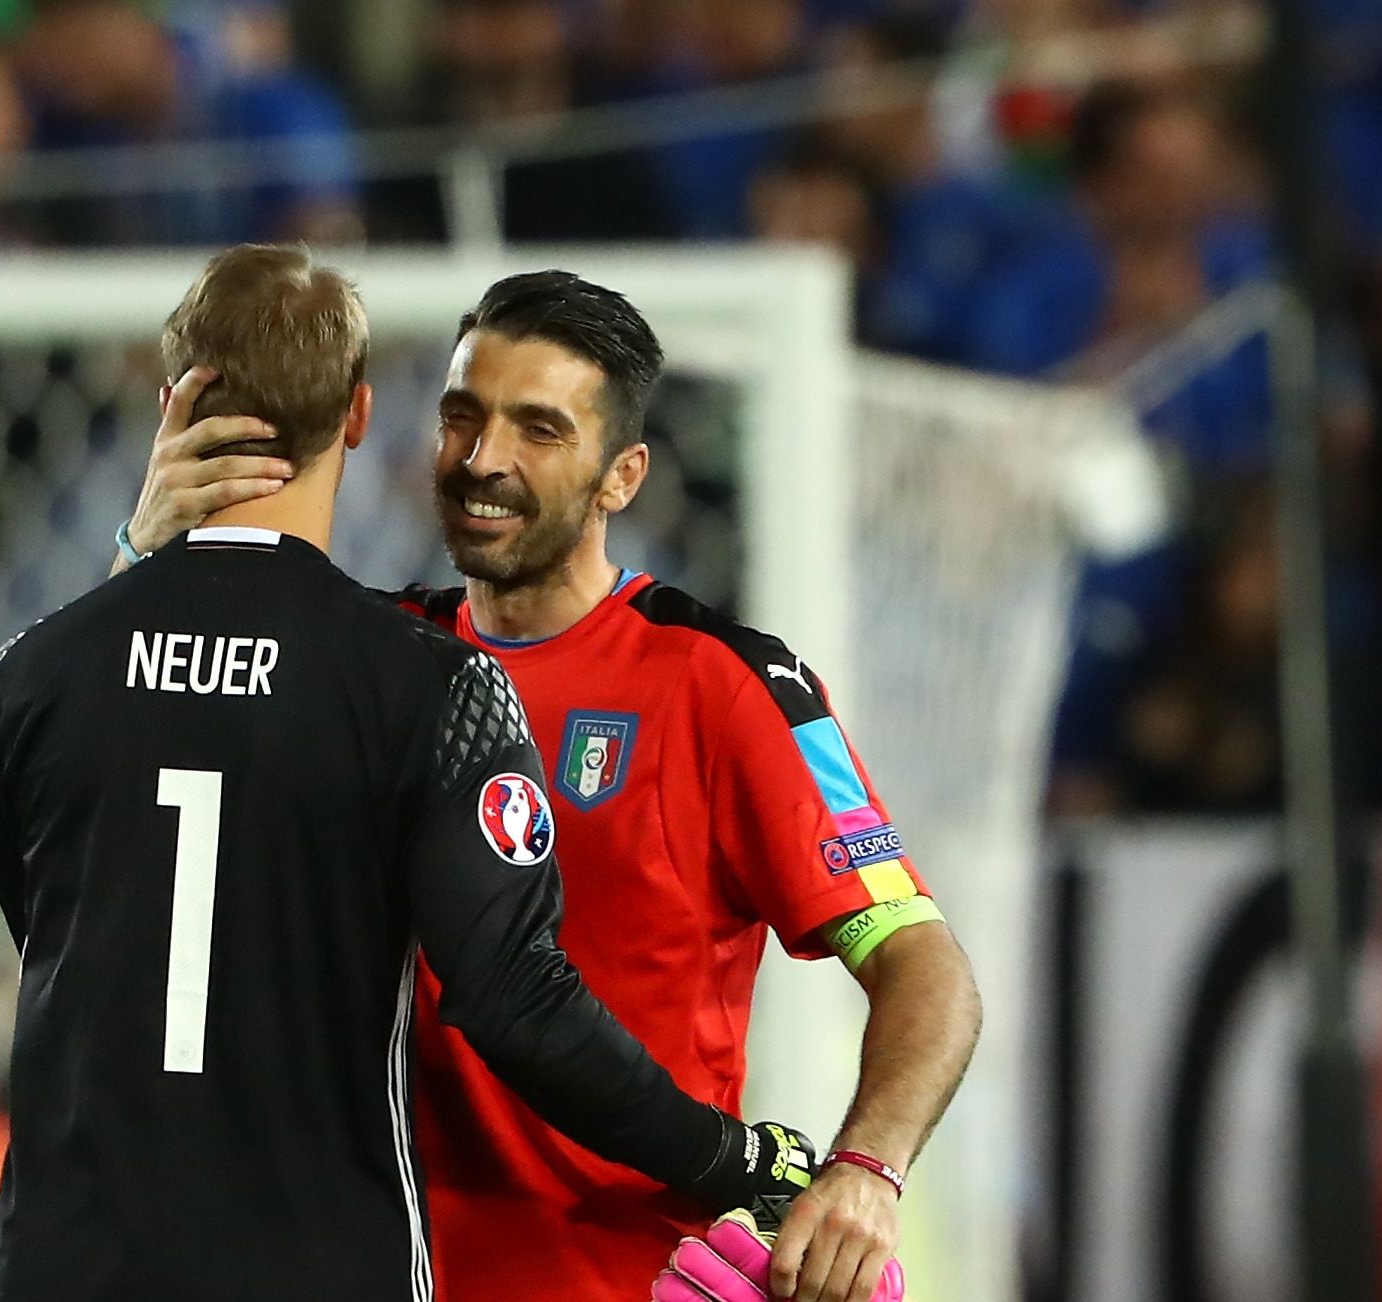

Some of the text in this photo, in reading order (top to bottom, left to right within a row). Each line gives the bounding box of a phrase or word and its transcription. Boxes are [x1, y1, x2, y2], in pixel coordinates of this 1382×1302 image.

[125, 630, 280, 696] NEUER
[579, 725, 618, 736] ITALIA
[156, 767, 223, 1074] 1
